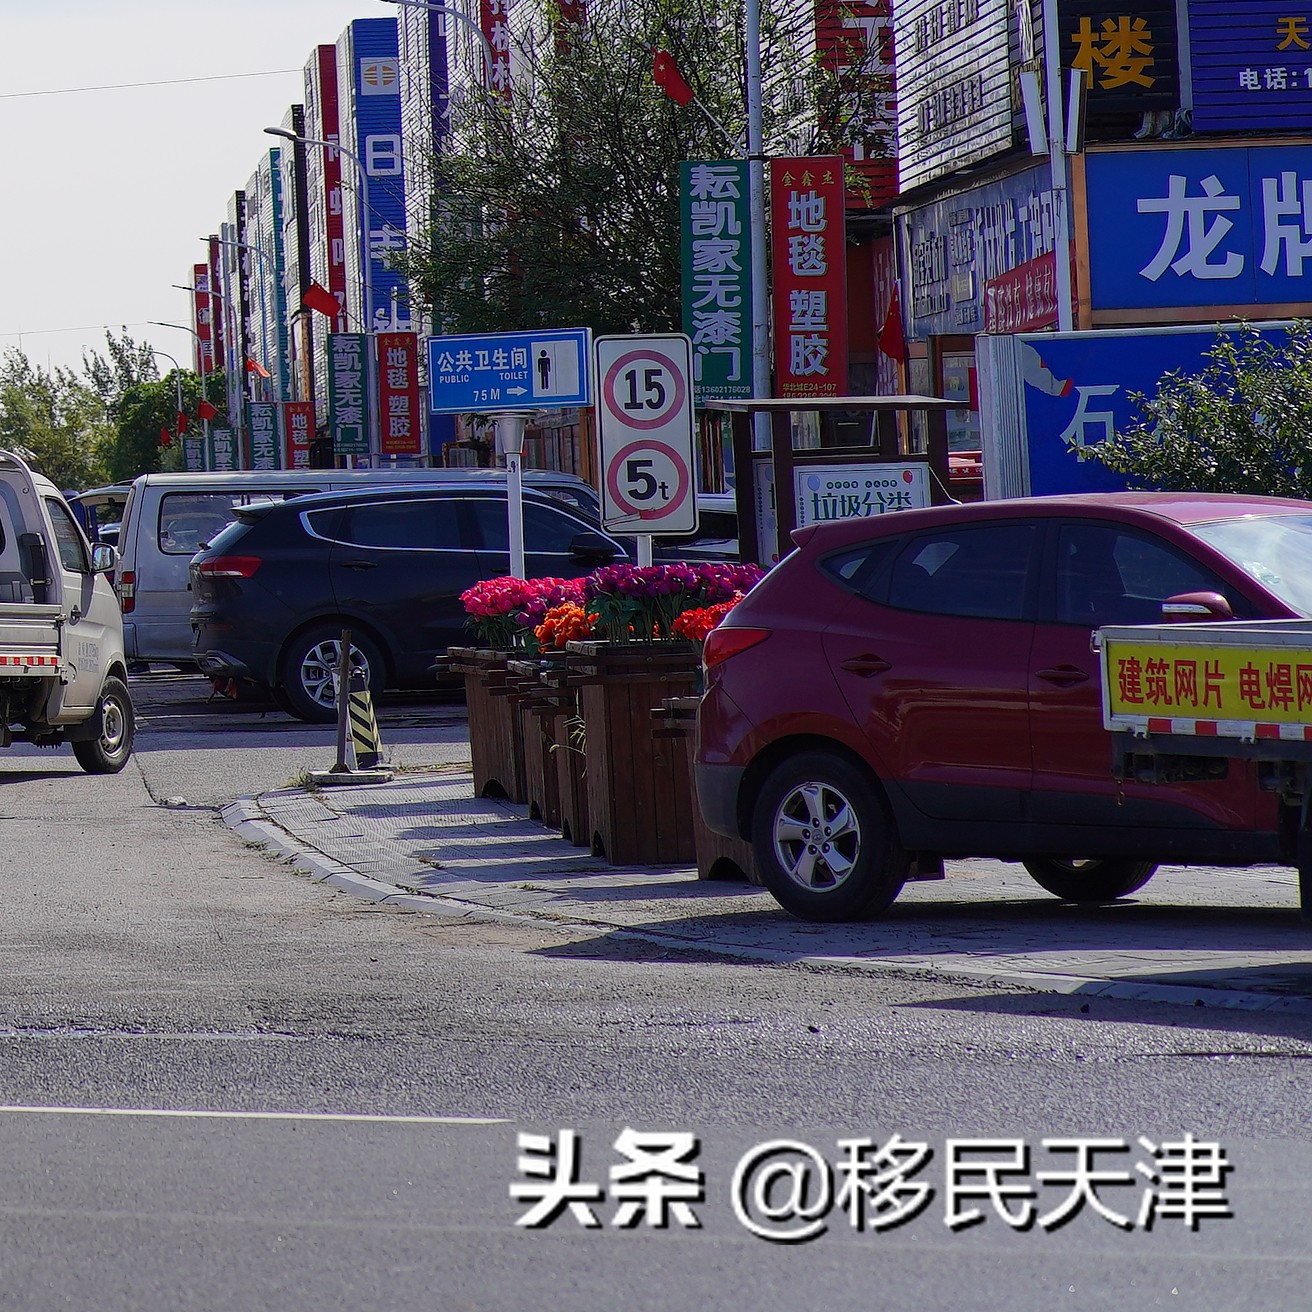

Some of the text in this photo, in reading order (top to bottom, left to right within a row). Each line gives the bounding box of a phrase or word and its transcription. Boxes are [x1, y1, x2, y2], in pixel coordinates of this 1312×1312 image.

[787, 190, 828, 277] 地毯
[689, 164, 743, 381] 耘凯家无漆门
[789, 289, 829, 377] 塑胶
[437, 346, 529, 372] 公共卫生间
[439, 370, 529, 385] PUBLIC TOILET
[332, 335, 363, 442] 耘凯家无漆门
[386, 347, 411, 437] 地毯 塑胶
[473, 389, 501, 402] 75M
[623, 368, 667, 411] 15
[626, 459, 670, 501] 5t
[811, 491, 913, 522] 垃圾分类
[1118, 656, 1225, 709] 建筑网片
